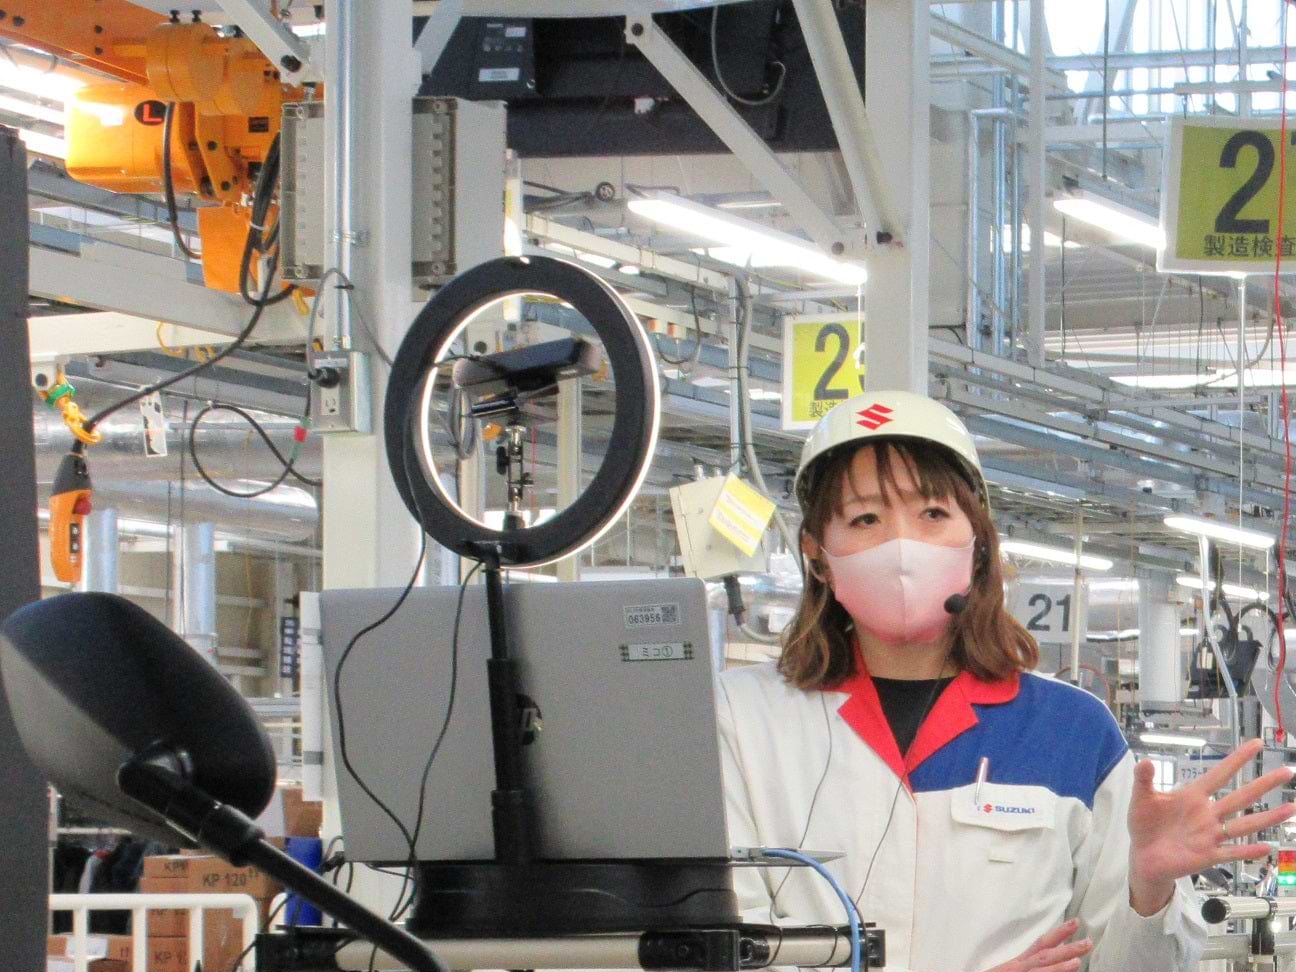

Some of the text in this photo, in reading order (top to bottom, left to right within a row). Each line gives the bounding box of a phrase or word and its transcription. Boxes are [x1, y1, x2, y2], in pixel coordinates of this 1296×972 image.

[142, 103, 163, 122] L
[813, 322, 865, 401] 2
[1026, 593, 1072, 632] 21
[994, 805, 1036, 814] SUZUKI
